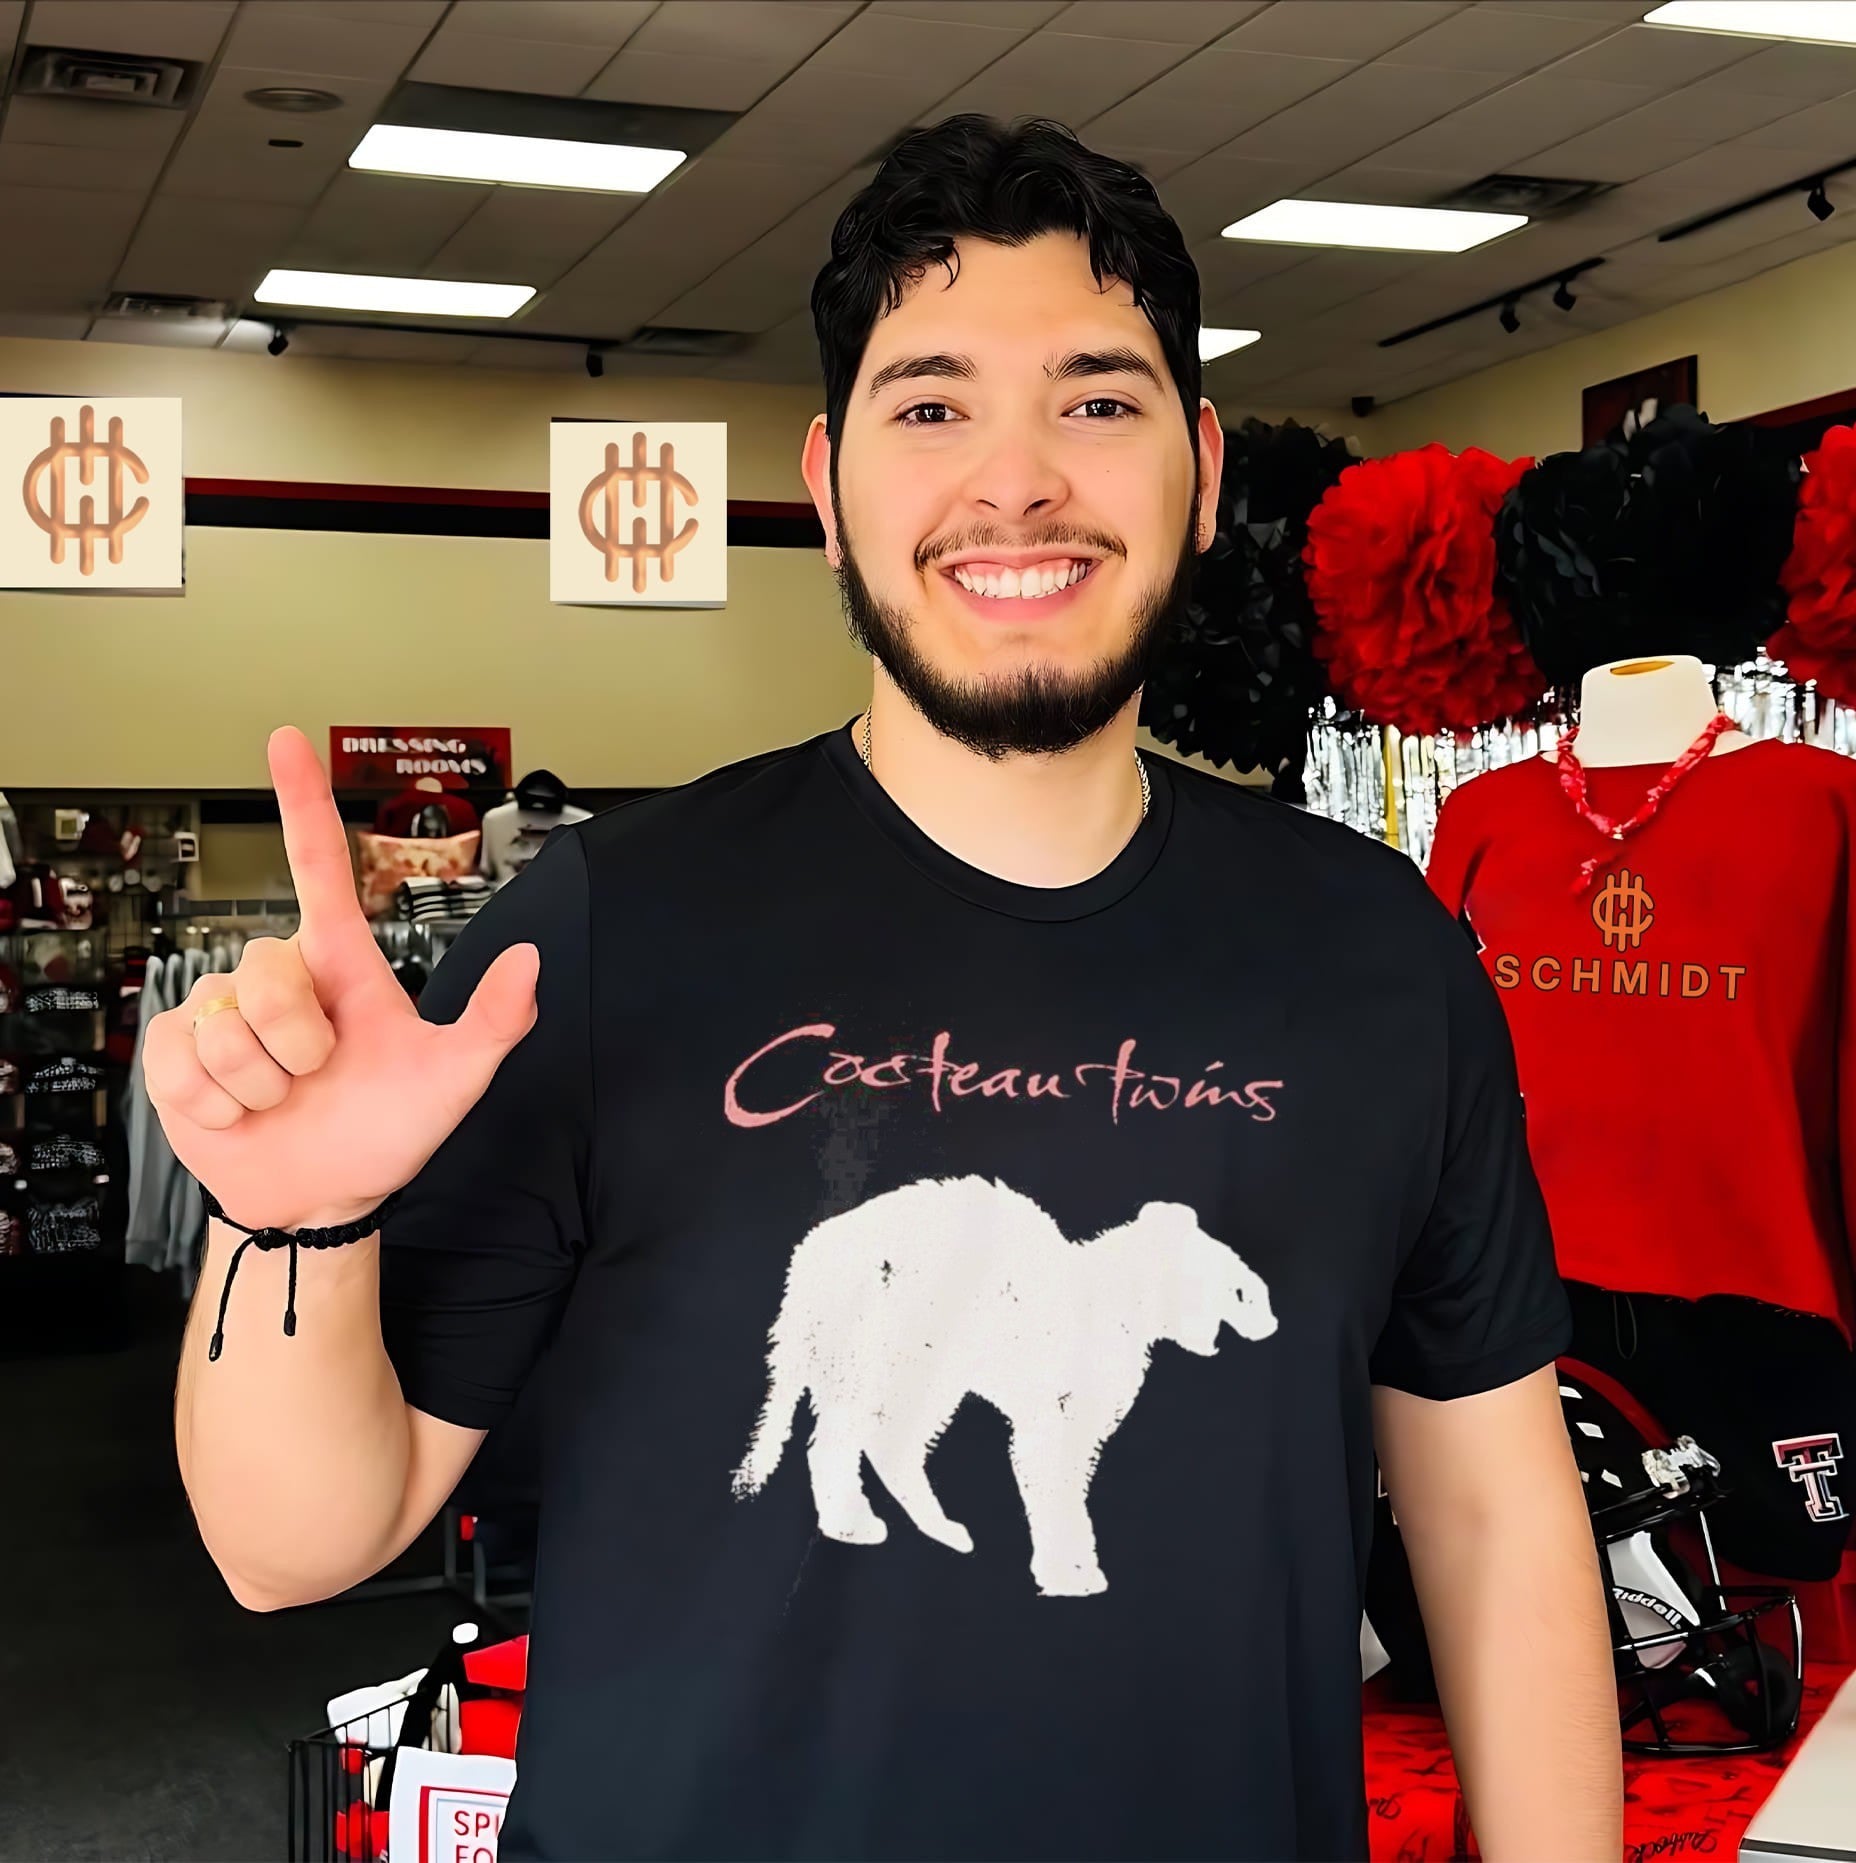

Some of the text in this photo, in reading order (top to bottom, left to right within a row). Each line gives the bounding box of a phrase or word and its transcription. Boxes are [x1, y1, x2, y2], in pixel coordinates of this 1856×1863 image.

[342, 737, 467, 754] DRESSING
[396, 758, 487, 775] ROOMS
[1494, 954, 1747, 1000] SCHMIDT
[724, 1023, 1072, 1128] Cocteau
